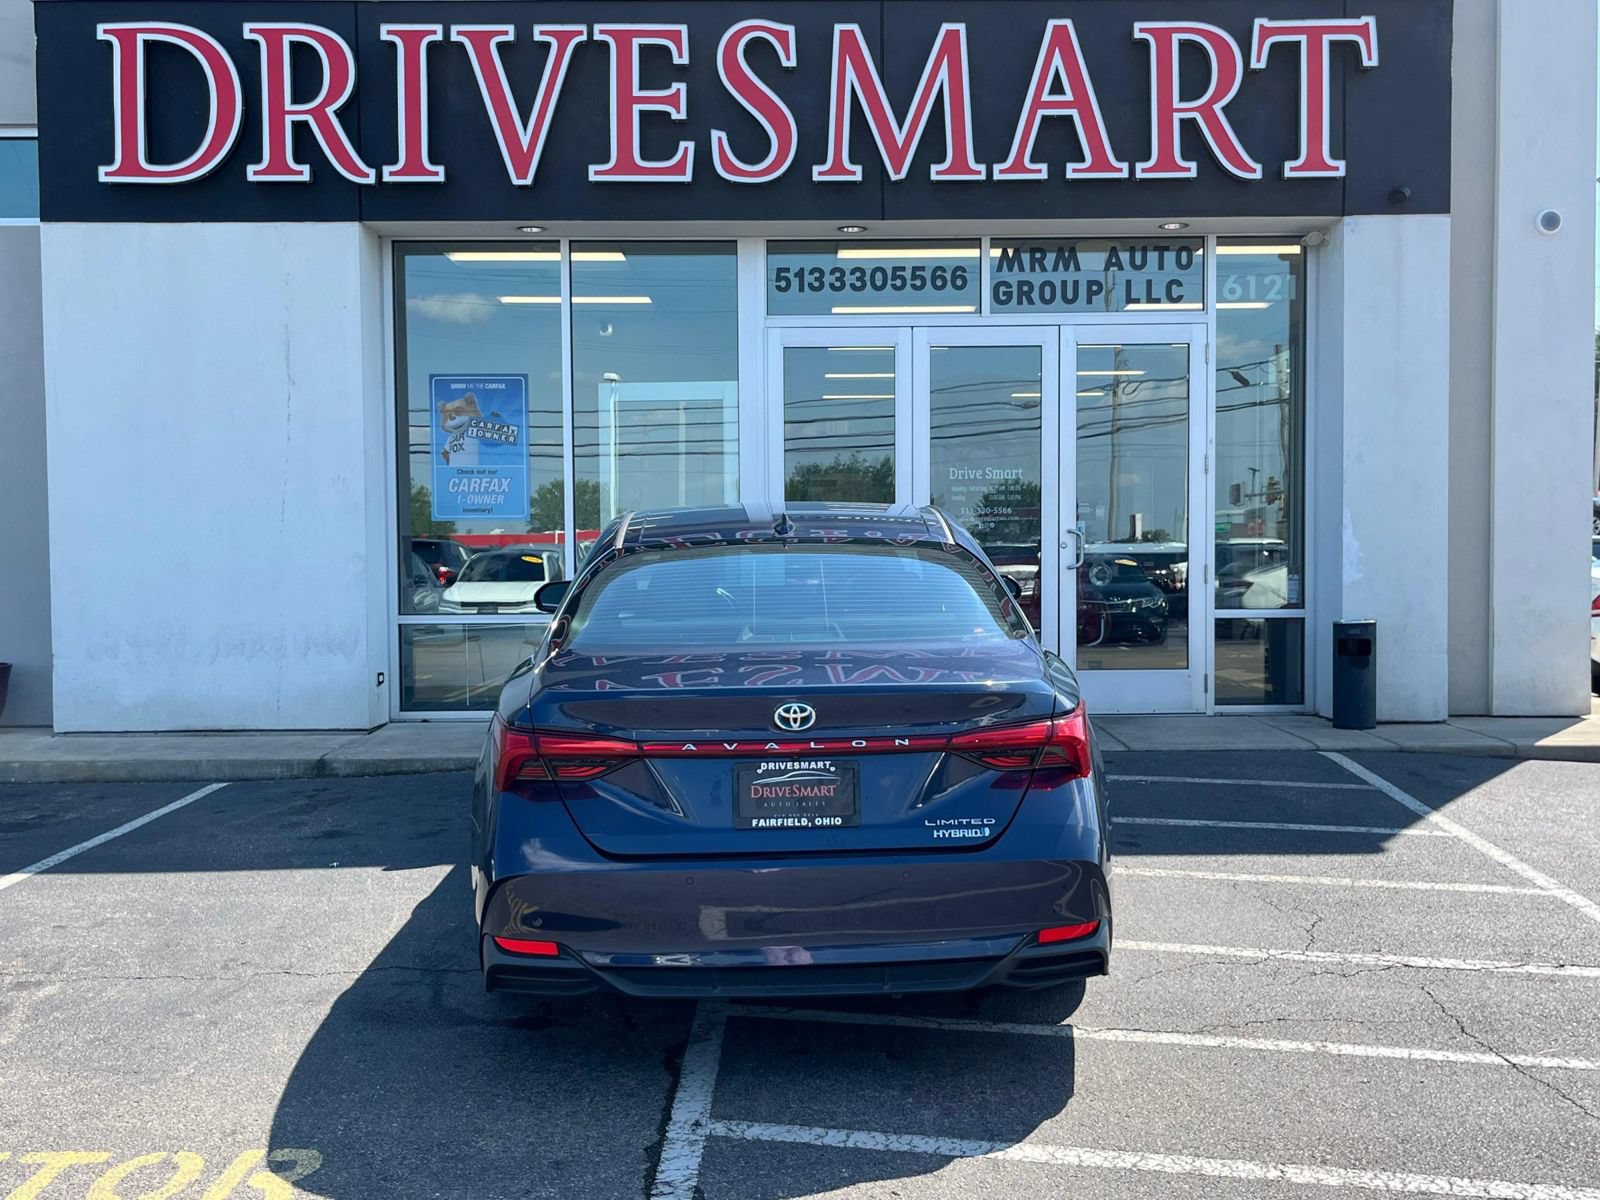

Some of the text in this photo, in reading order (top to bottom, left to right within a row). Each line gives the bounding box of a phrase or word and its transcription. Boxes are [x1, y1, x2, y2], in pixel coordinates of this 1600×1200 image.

[96, 15, 1380, 187] DRIVESMART
[995, 245, 1195, 273] MRM AUTO
[774, 265, 969, 294] 5133305566
[993, 278, 1186, 307] GROUP LLC
[470, 419, 518, 436] CARFAX
[949, 466, 1024, 480] Drive Smart
[448, 478, 511, 493] CARFAX
[457, 494, 504, 505] 1-OWNER
[682, 738, 911, 751] AVALON
[760, 761, 832, 771] DRIVESMART
[752, 816, 842, 828] FAIRFIELD, OHIO
[924, 818, 996, 826] LIMITED
[933, 828, 981, 838] HYBRID
